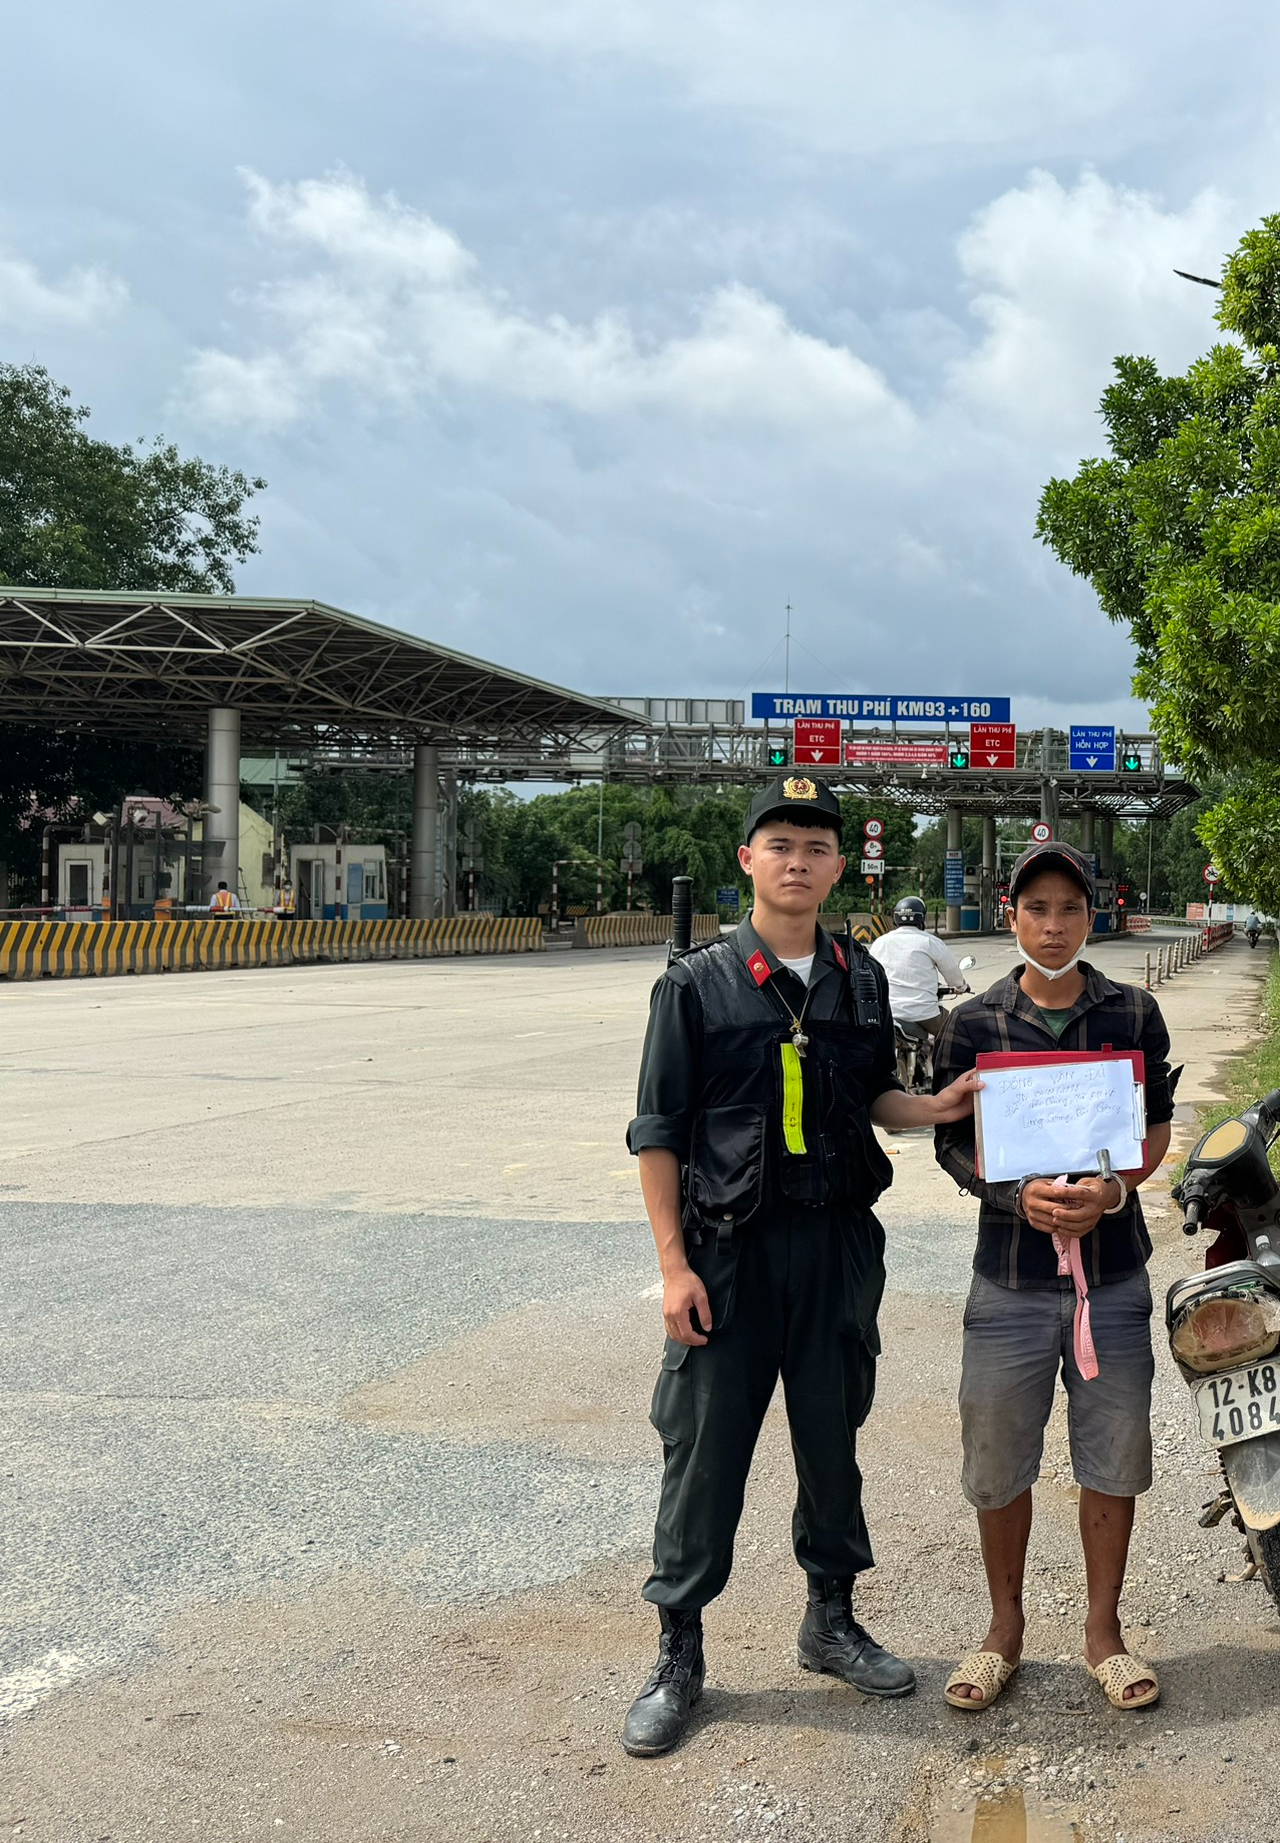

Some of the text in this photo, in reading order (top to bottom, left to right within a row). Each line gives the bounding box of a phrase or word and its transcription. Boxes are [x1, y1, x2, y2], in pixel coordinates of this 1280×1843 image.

[773, 698, 822, 717] TRẠM
[827, 700, 859, 716] THU
[862, 697, 891, 716] PHÍ
[1072, 729, 1086, 737] LÀN
[809, 734, 825, 743] ETC
[985, 739, 1000, 747] ETC
[869, 824, 879, 833] 40
[1037, 828, 1046, 838] 40
[1208, 1365, 1277, 1409] 12-K8
